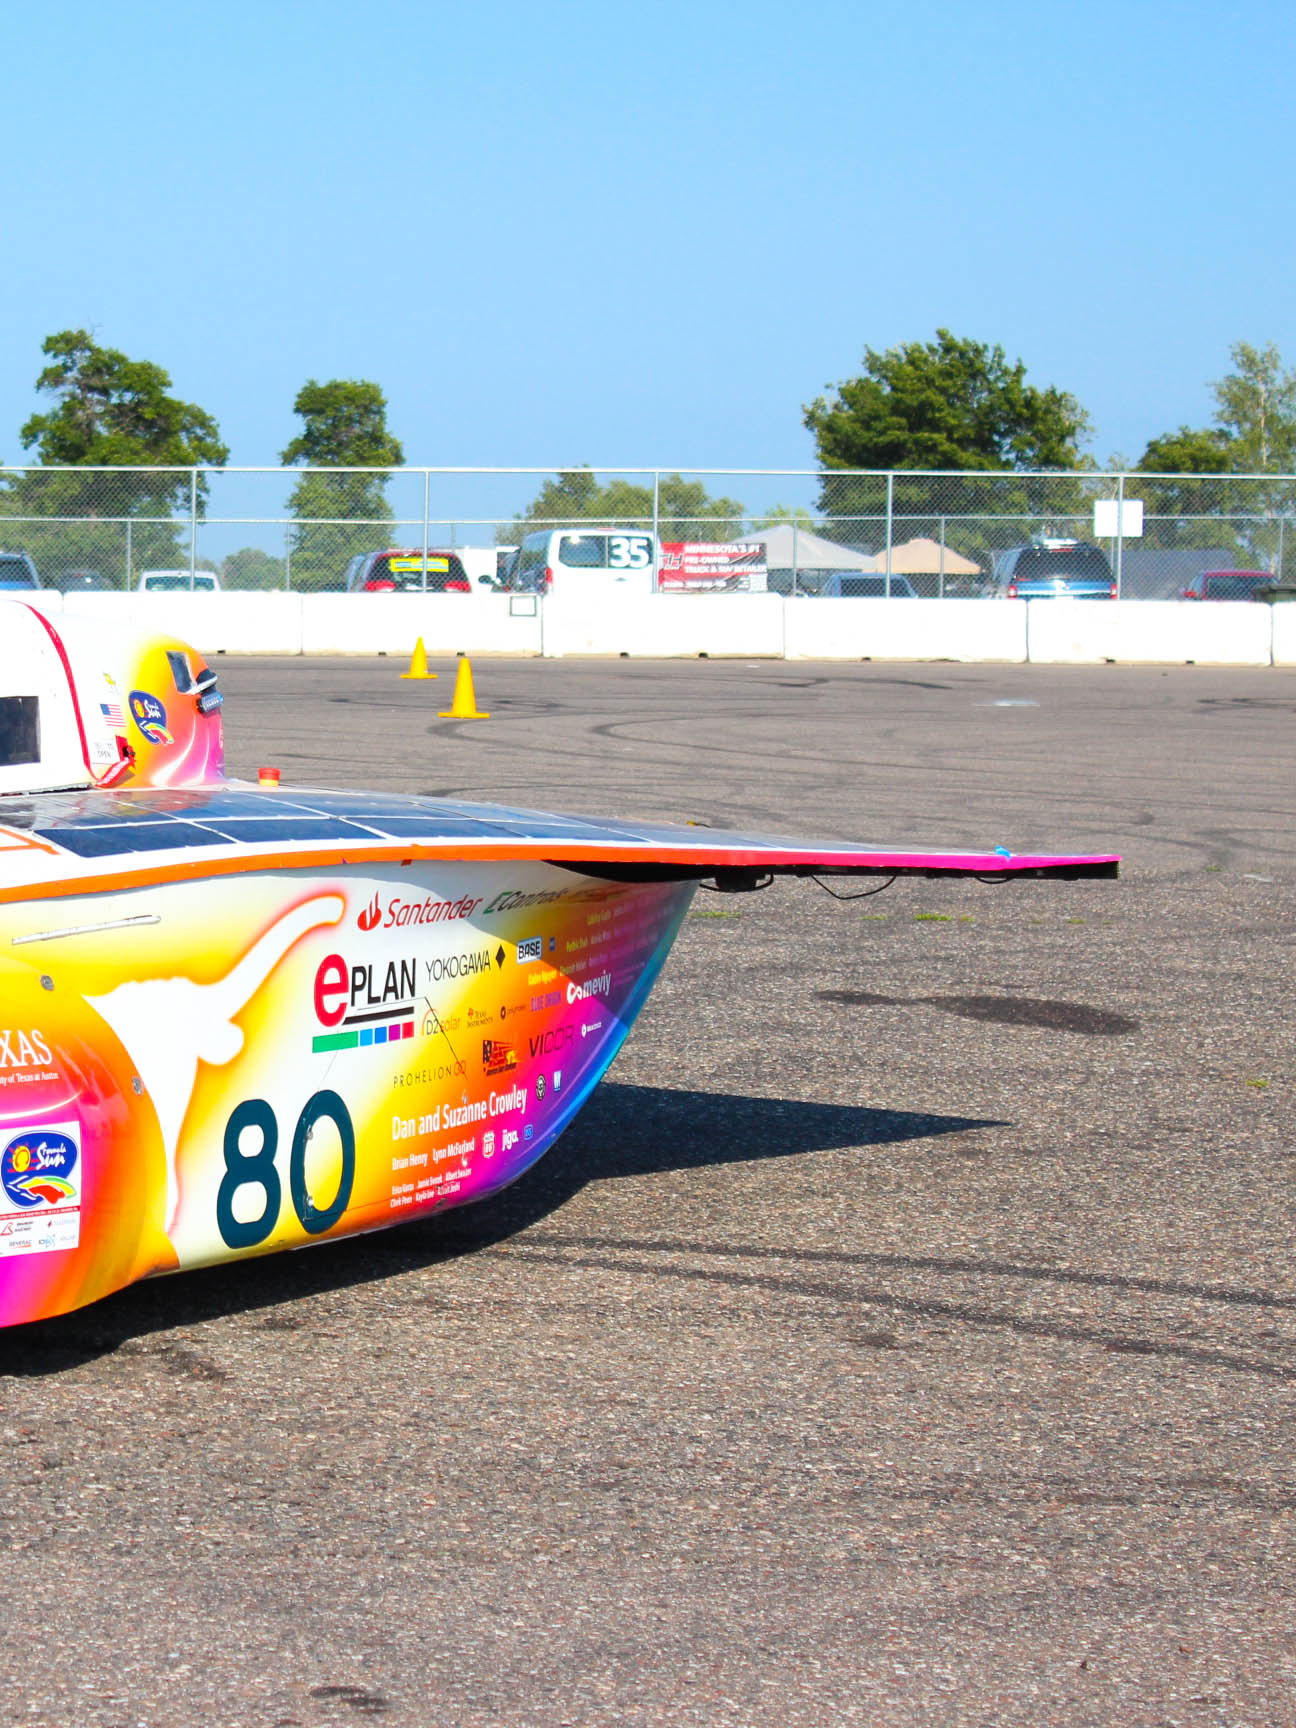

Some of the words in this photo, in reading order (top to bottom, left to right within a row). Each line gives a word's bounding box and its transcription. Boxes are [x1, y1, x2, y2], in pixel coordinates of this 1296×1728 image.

[610, 538, 649, 567] 35
[684, 544, 746, 554] MINNESOTA'S
[383, 894, 483, 928] Santander
[518, 940, 541, 959] BASE
[425, 950, 491, 982] YOKOGAWA
[529, 1025, 575, 1058] VICOR
[16, 1072, 34, 1083] Texas
[41, 1071, 59, 1081] Austin
[393, 1065, 452, 1088] PROHELION
[392, 1116, 416, 1141] Dan
[418, 1105, 440, 1136] and
[442, 1101, 487, 1129] Suzanne
[489, 1084, 528, 1116] Crowley
[216, 1089, 356, 1249] 80
[392, 1157, 409, 1171] Brian
[410, 1153, 428, 1168] Henry
[432, 1148, 447, 1164] Lynn
[447, 1136, 475, 1159] McFarland
